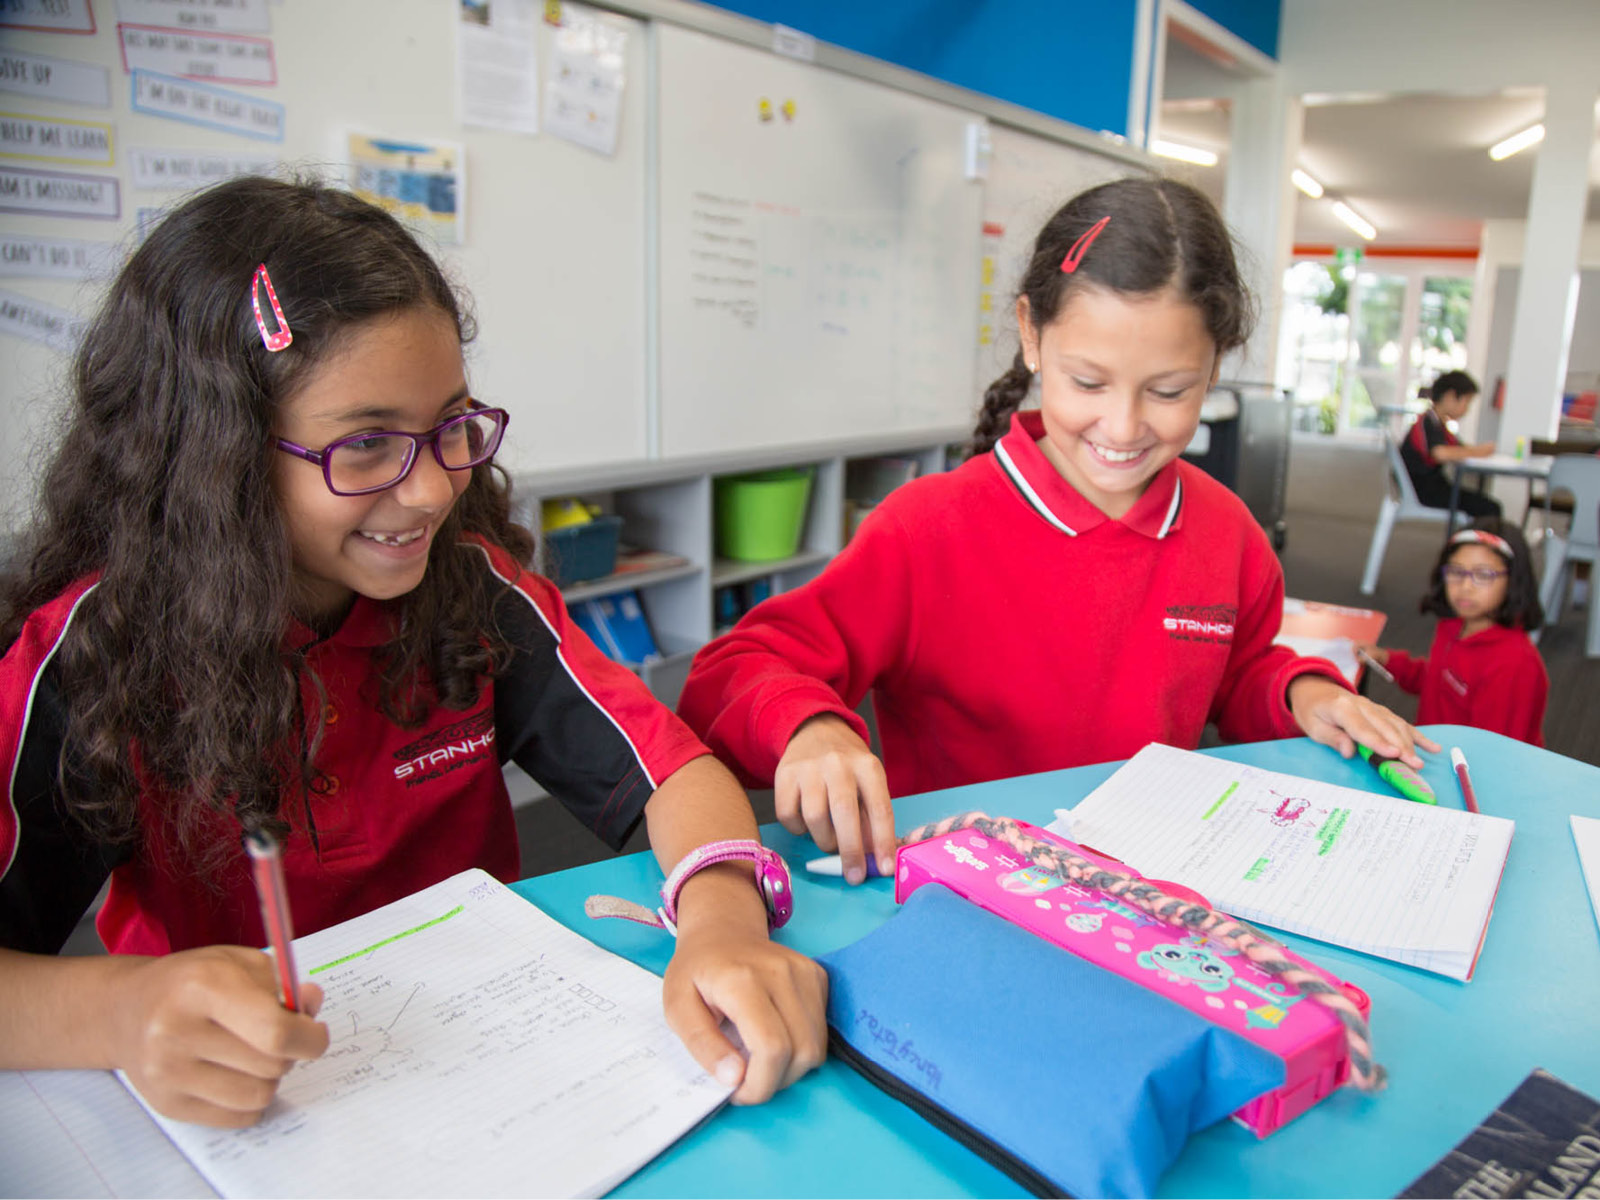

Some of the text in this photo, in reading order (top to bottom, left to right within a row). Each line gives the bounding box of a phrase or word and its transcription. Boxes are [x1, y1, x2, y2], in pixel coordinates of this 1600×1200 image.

[33, 63, 52, 87] UP
[40, 125, 61, 147] ME
[24, 178, 32, 199] I
[2, 242, 46, 264] CAN'T
[50, 245, 70, 269] DO
